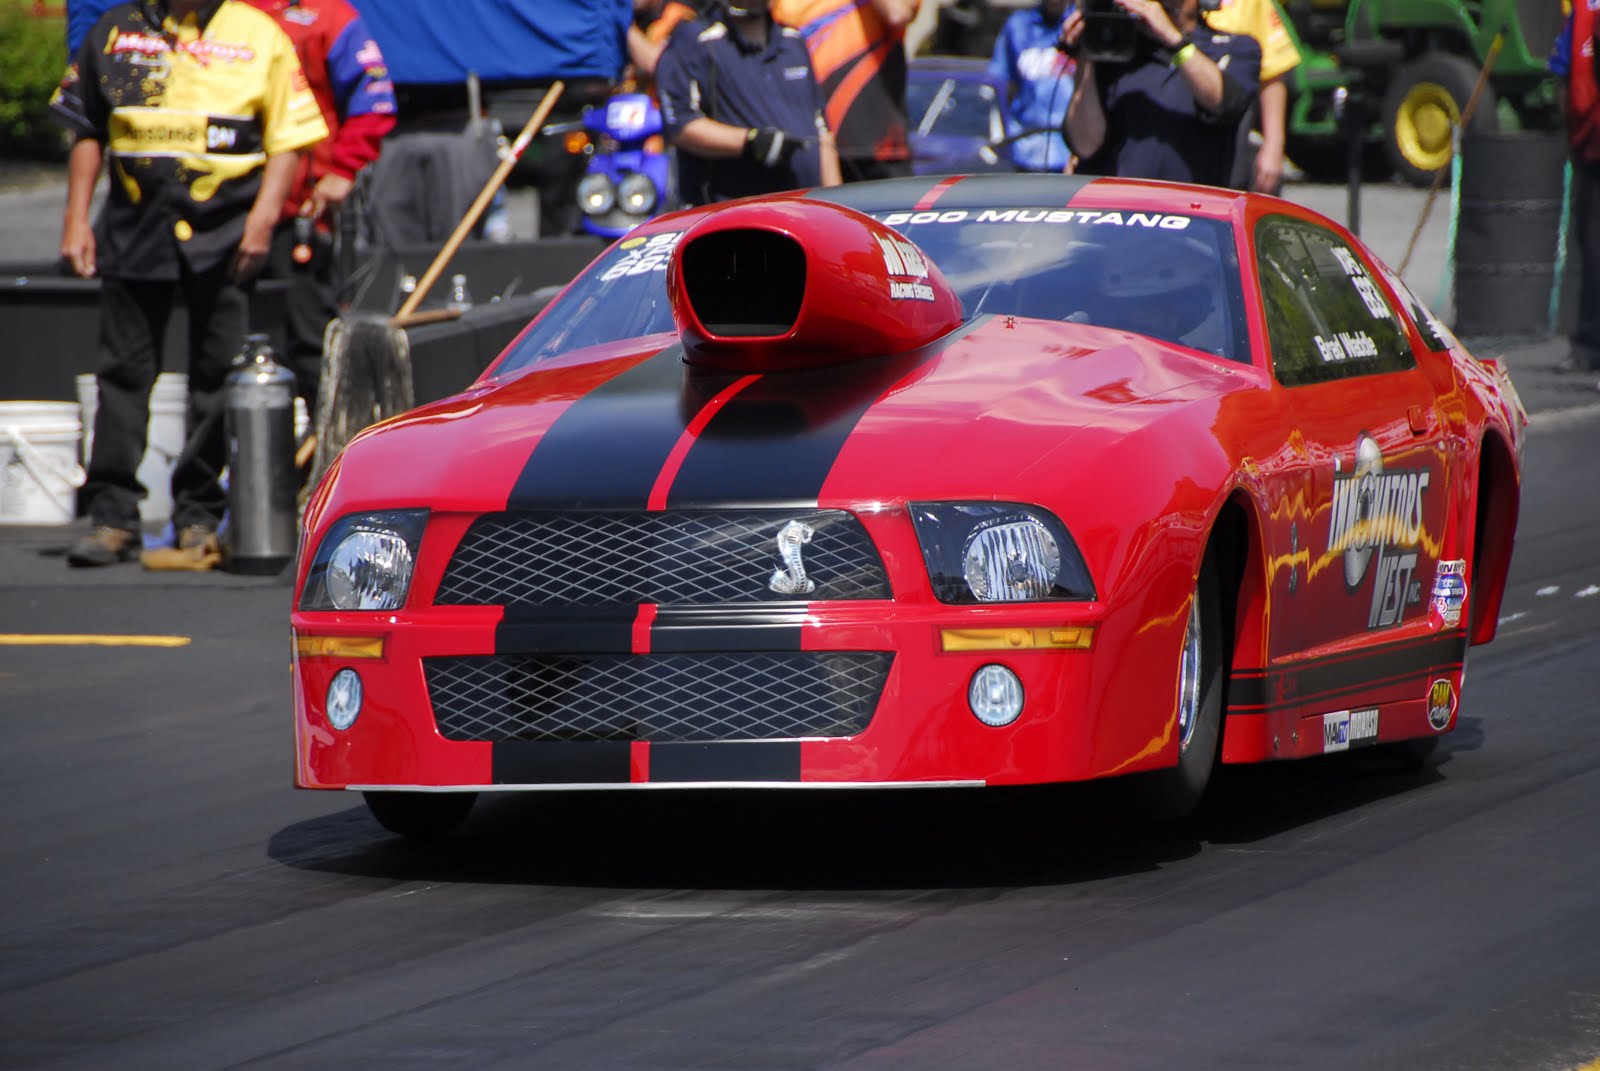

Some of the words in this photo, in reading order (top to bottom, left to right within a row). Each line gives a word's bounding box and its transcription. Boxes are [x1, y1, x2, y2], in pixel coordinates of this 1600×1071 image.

[976, 209, 1192, 230] MUSTANG
[1314, 335, 1346, 361] Brad
[1367, 552, 1418, 629] WEST
[1432, 682, 1451, 707] RAM
